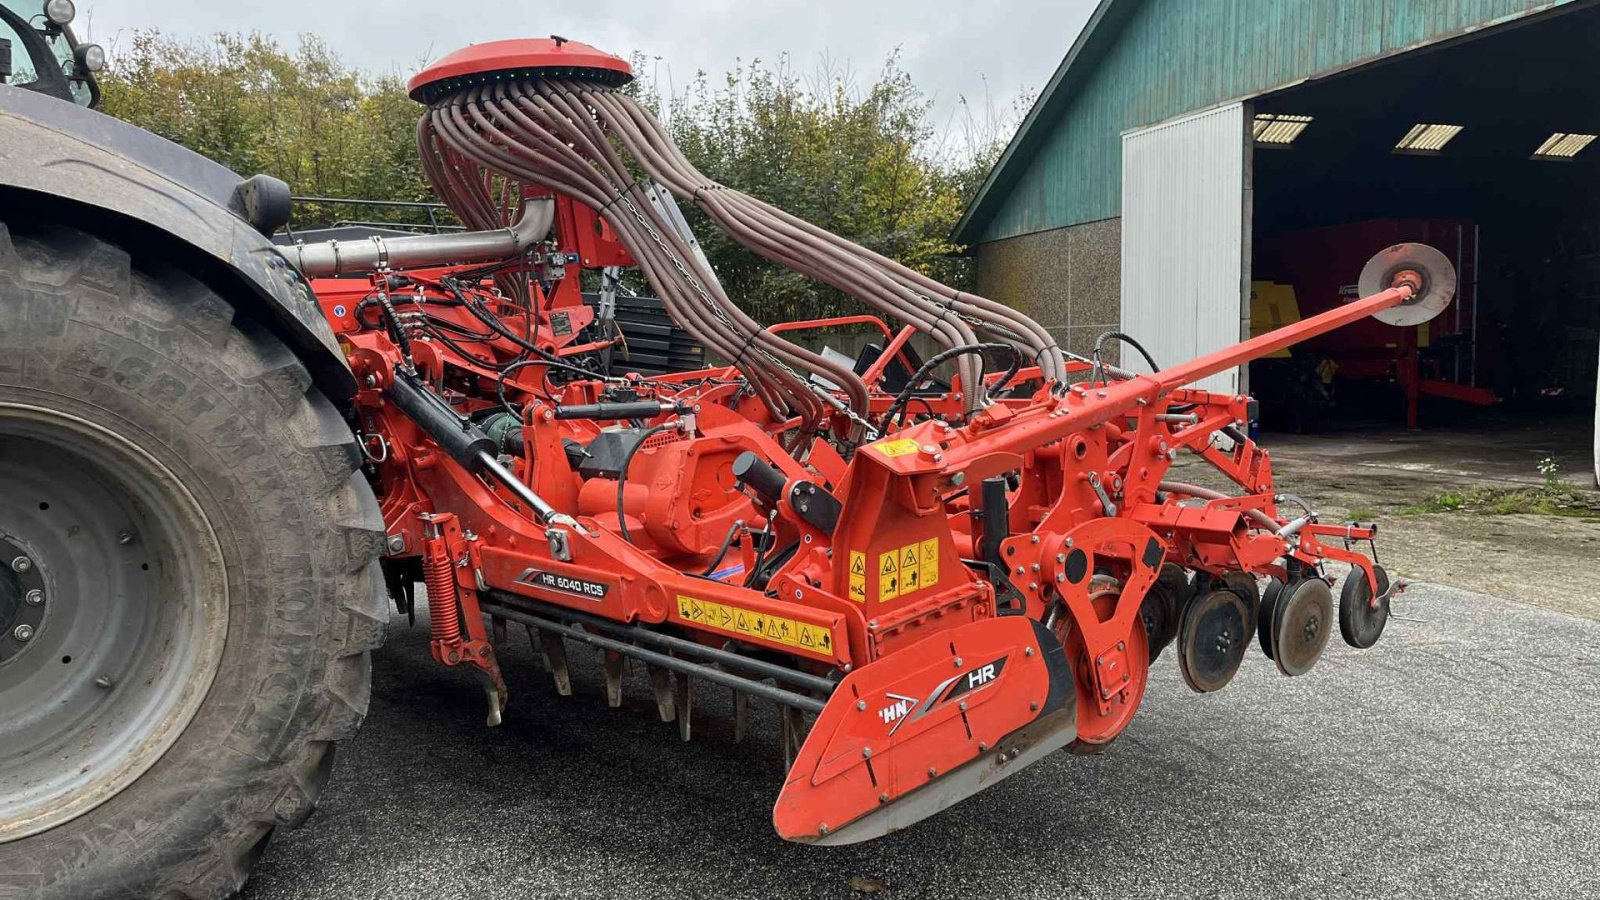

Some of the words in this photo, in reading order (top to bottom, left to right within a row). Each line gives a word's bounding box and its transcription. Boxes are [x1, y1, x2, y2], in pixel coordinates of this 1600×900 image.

[542, 573, 556, 586] HR
[557, 577, 582, 592] 6040
[583, 582, 604, 597] RCS
[968, 664, 996, 689] HR
